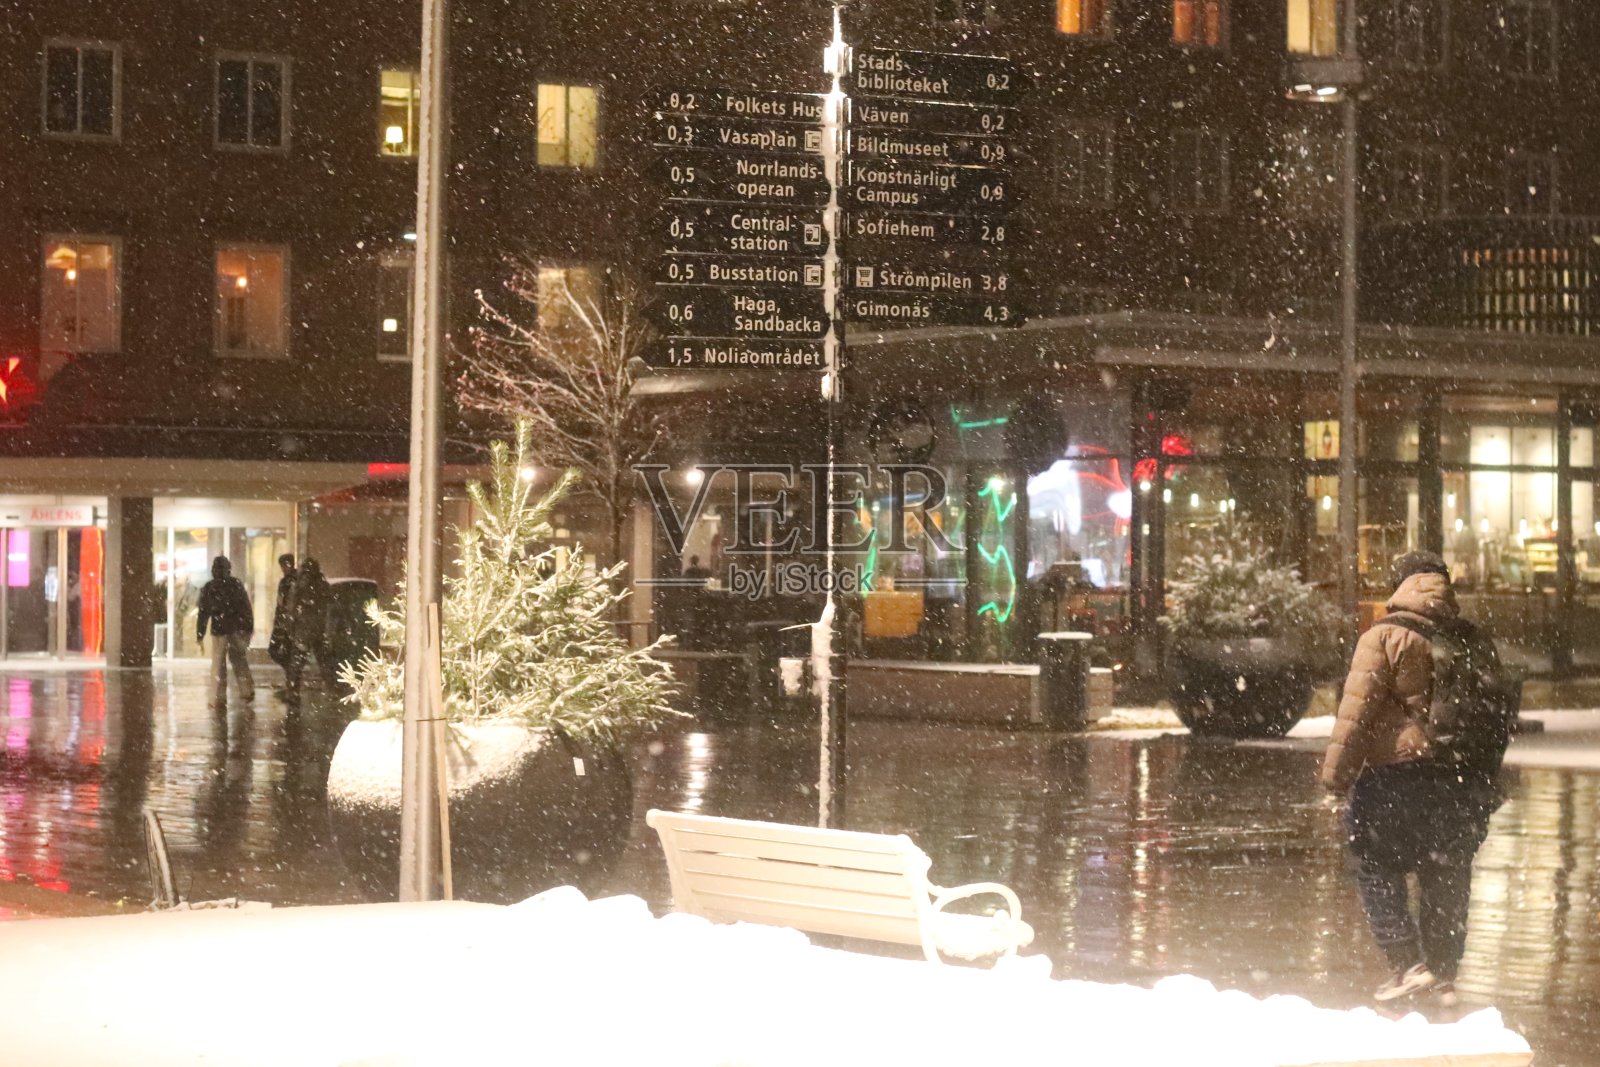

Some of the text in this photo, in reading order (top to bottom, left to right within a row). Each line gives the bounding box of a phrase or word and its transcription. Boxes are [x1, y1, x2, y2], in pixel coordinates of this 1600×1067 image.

[858, 70, 1010, 94] biblioteket 0,2
[670, 92, 823, 118] 0,2 Folkets Hus
[859, 106, 1005, 132] Väven 0,2
[667, 125, 797, 149] 0,3 Vasaplan
[857, 136, 1005, 163] Bildmuseet 0,9
[670, 166, 695, 184] 0,5
[736, 159, 823, 179] Norrlands-
[856, 167, 957, 191] Konstnärligt
[736, 182, 795, 198] operan
[856, 185, 1004, 206] Campus 0,9
[670, 219, 694, 239] 0,5
[730, 214, 796, 232] Central-
[857, 218, 1005, 244] Sofiehem 2,8
[730, 235, 788, 251] station
[668, 263, 798, 282] 0,5 Busstation
[880, 270, 1007, 292] Strömpilen 3,8
[669, 304, 694, 322] 0,6
[734, 296, 781, 314] Haga,
[856, 301, 1009, 322] Gimonäs 4,3
[734, 315, 821, 332] Sandbacka
[667, 347, 820, 366] 1,5 Noliaområdet
